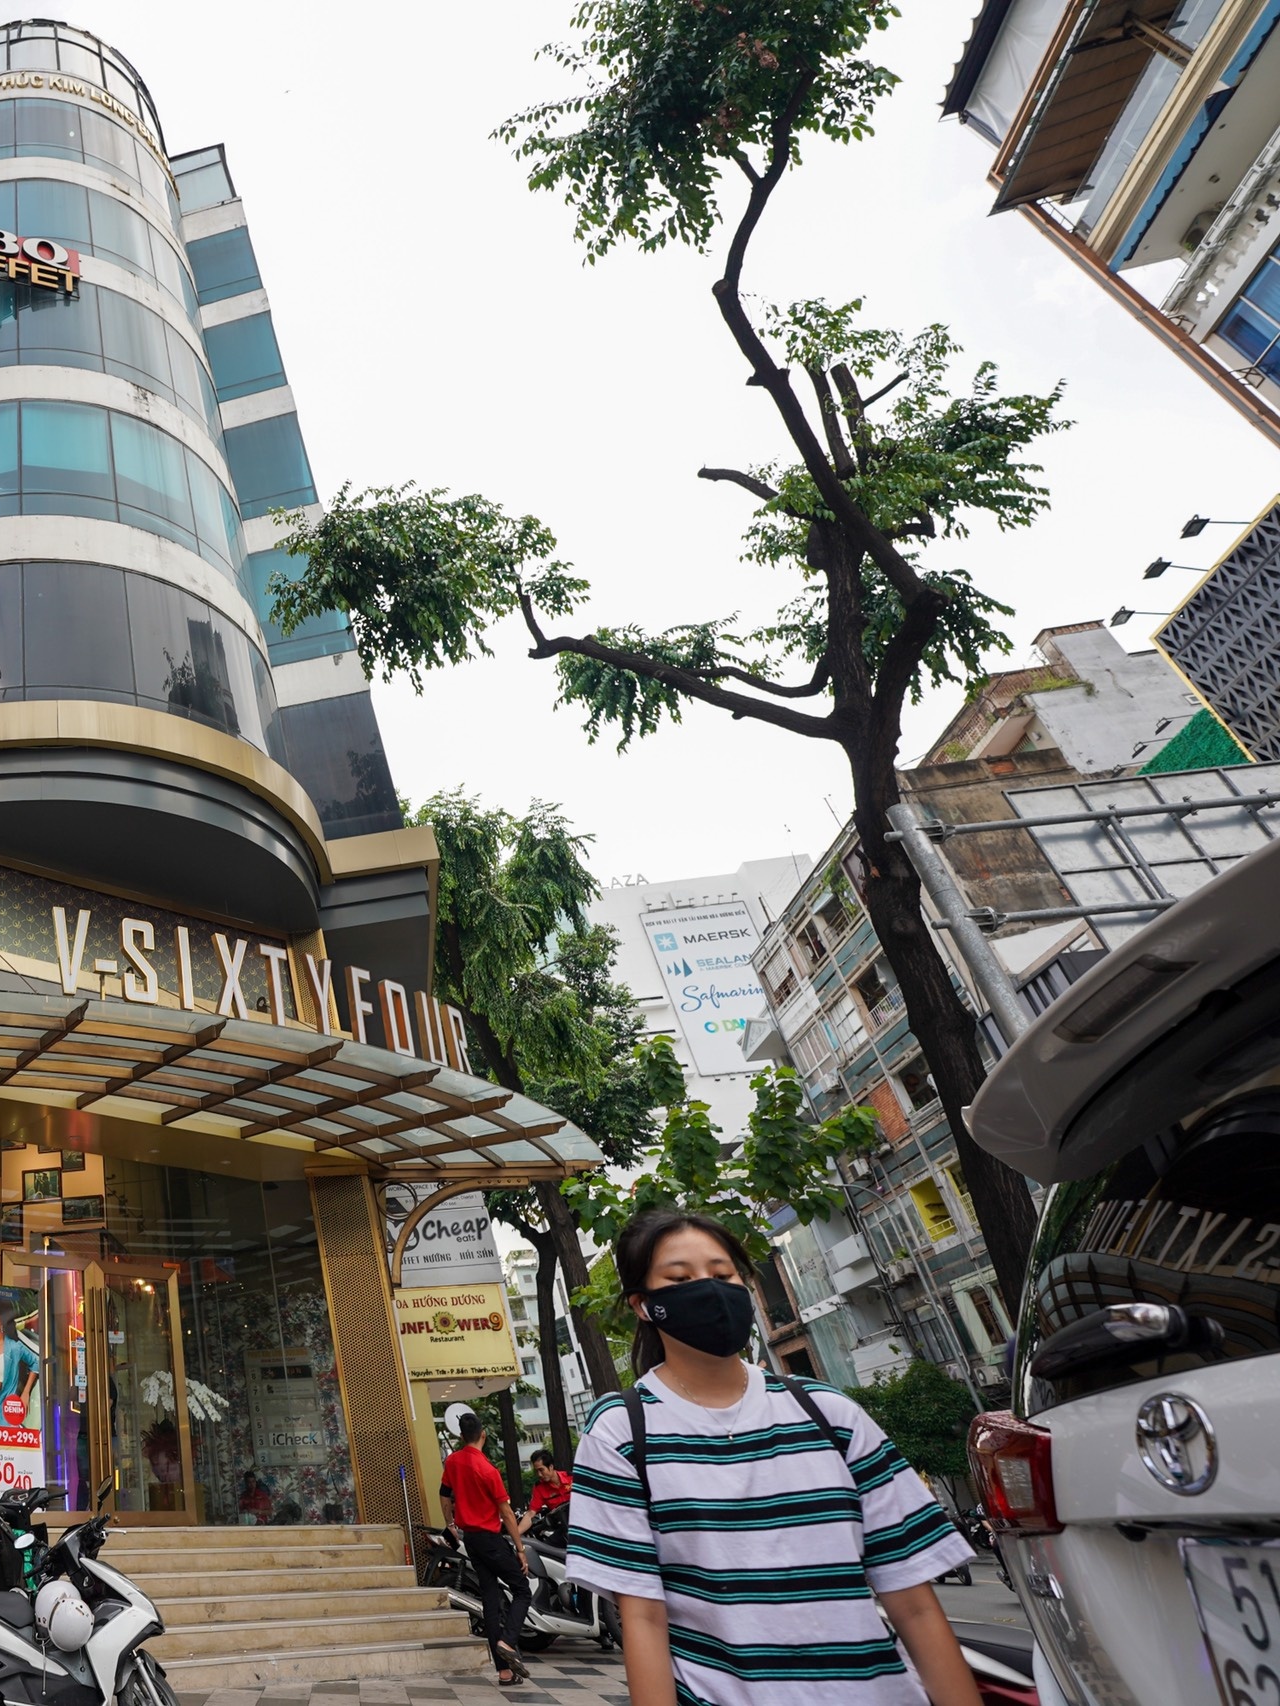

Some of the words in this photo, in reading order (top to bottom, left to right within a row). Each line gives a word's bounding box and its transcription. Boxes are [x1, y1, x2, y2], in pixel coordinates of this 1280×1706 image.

[49, 74, 86, 97] KIM
[91, 88, 136, 127] LONG
[599, 873, 650, 890] LAZA
[683, 928, 752, 944] MAERSK
[696, 953, 752, 968] SEALAN
[52, 906, 474, 1076] V-SIXTYFOUR
[680, 984, 765, 1013] Safmarin
[421, 1217, 489, 1241] Cheap
[456, 1234, 476, 1243] eats
[401, 1255, 420, 1266] FFET
[396, 1299, 409, 1309] OA
[429, 1335, 465, 1343] Restaurant
[4, 1405, 24, 1415] DENIM
